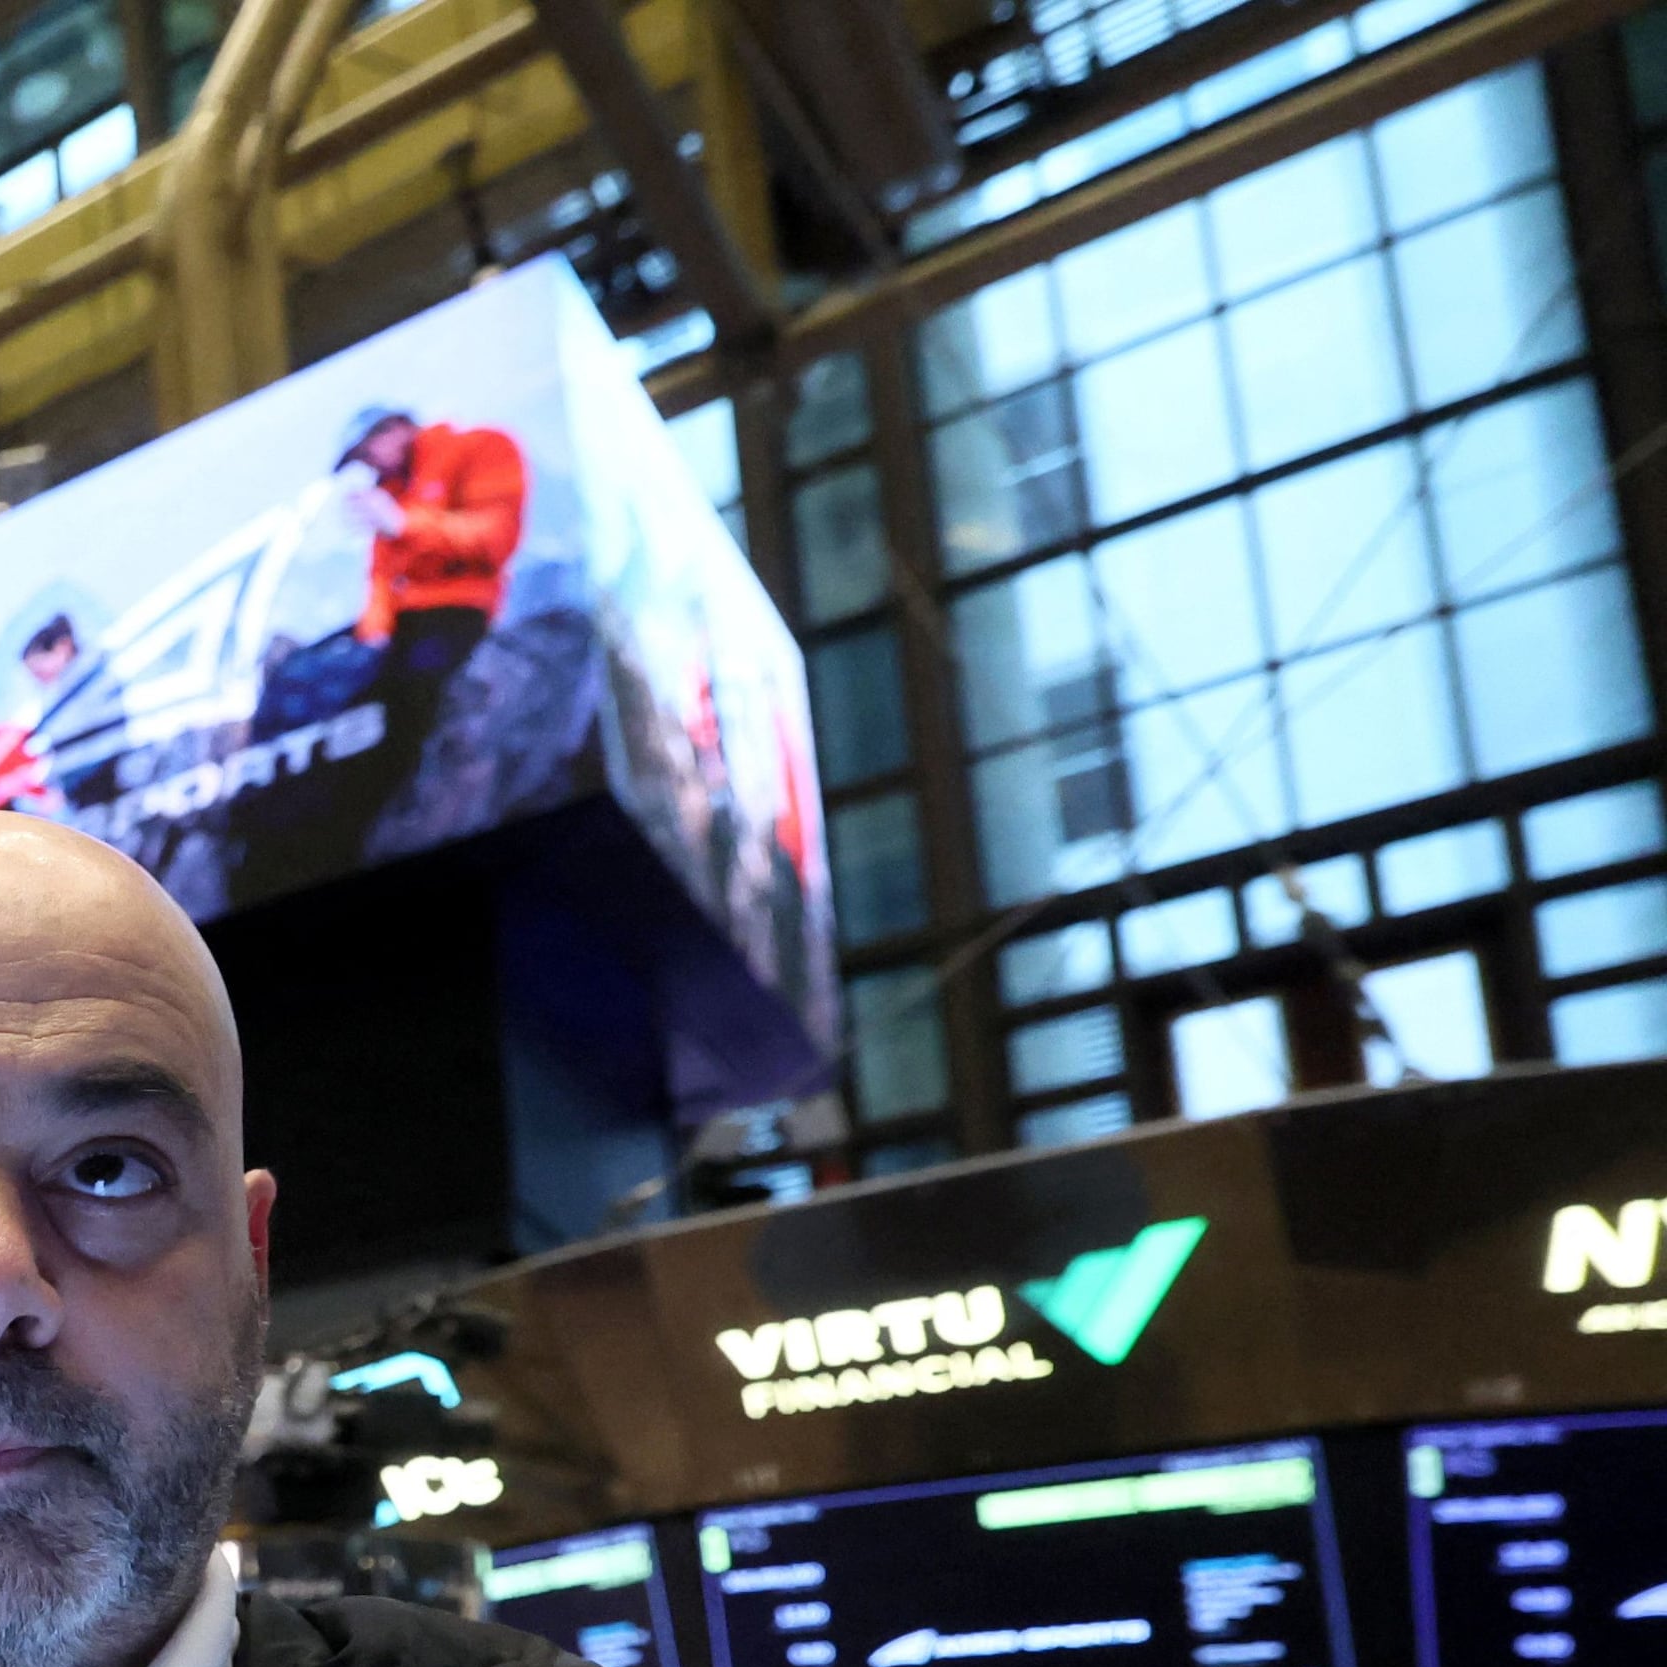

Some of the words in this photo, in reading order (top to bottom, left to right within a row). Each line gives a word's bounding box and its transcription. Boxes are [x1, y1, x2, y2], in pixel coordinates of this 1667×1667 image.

[1542, 1197, 1667, 1294] N
[715, 1285, 1006, 1380] VIRTU
[741, 1341, 1055, 1420] FINANCIAL
